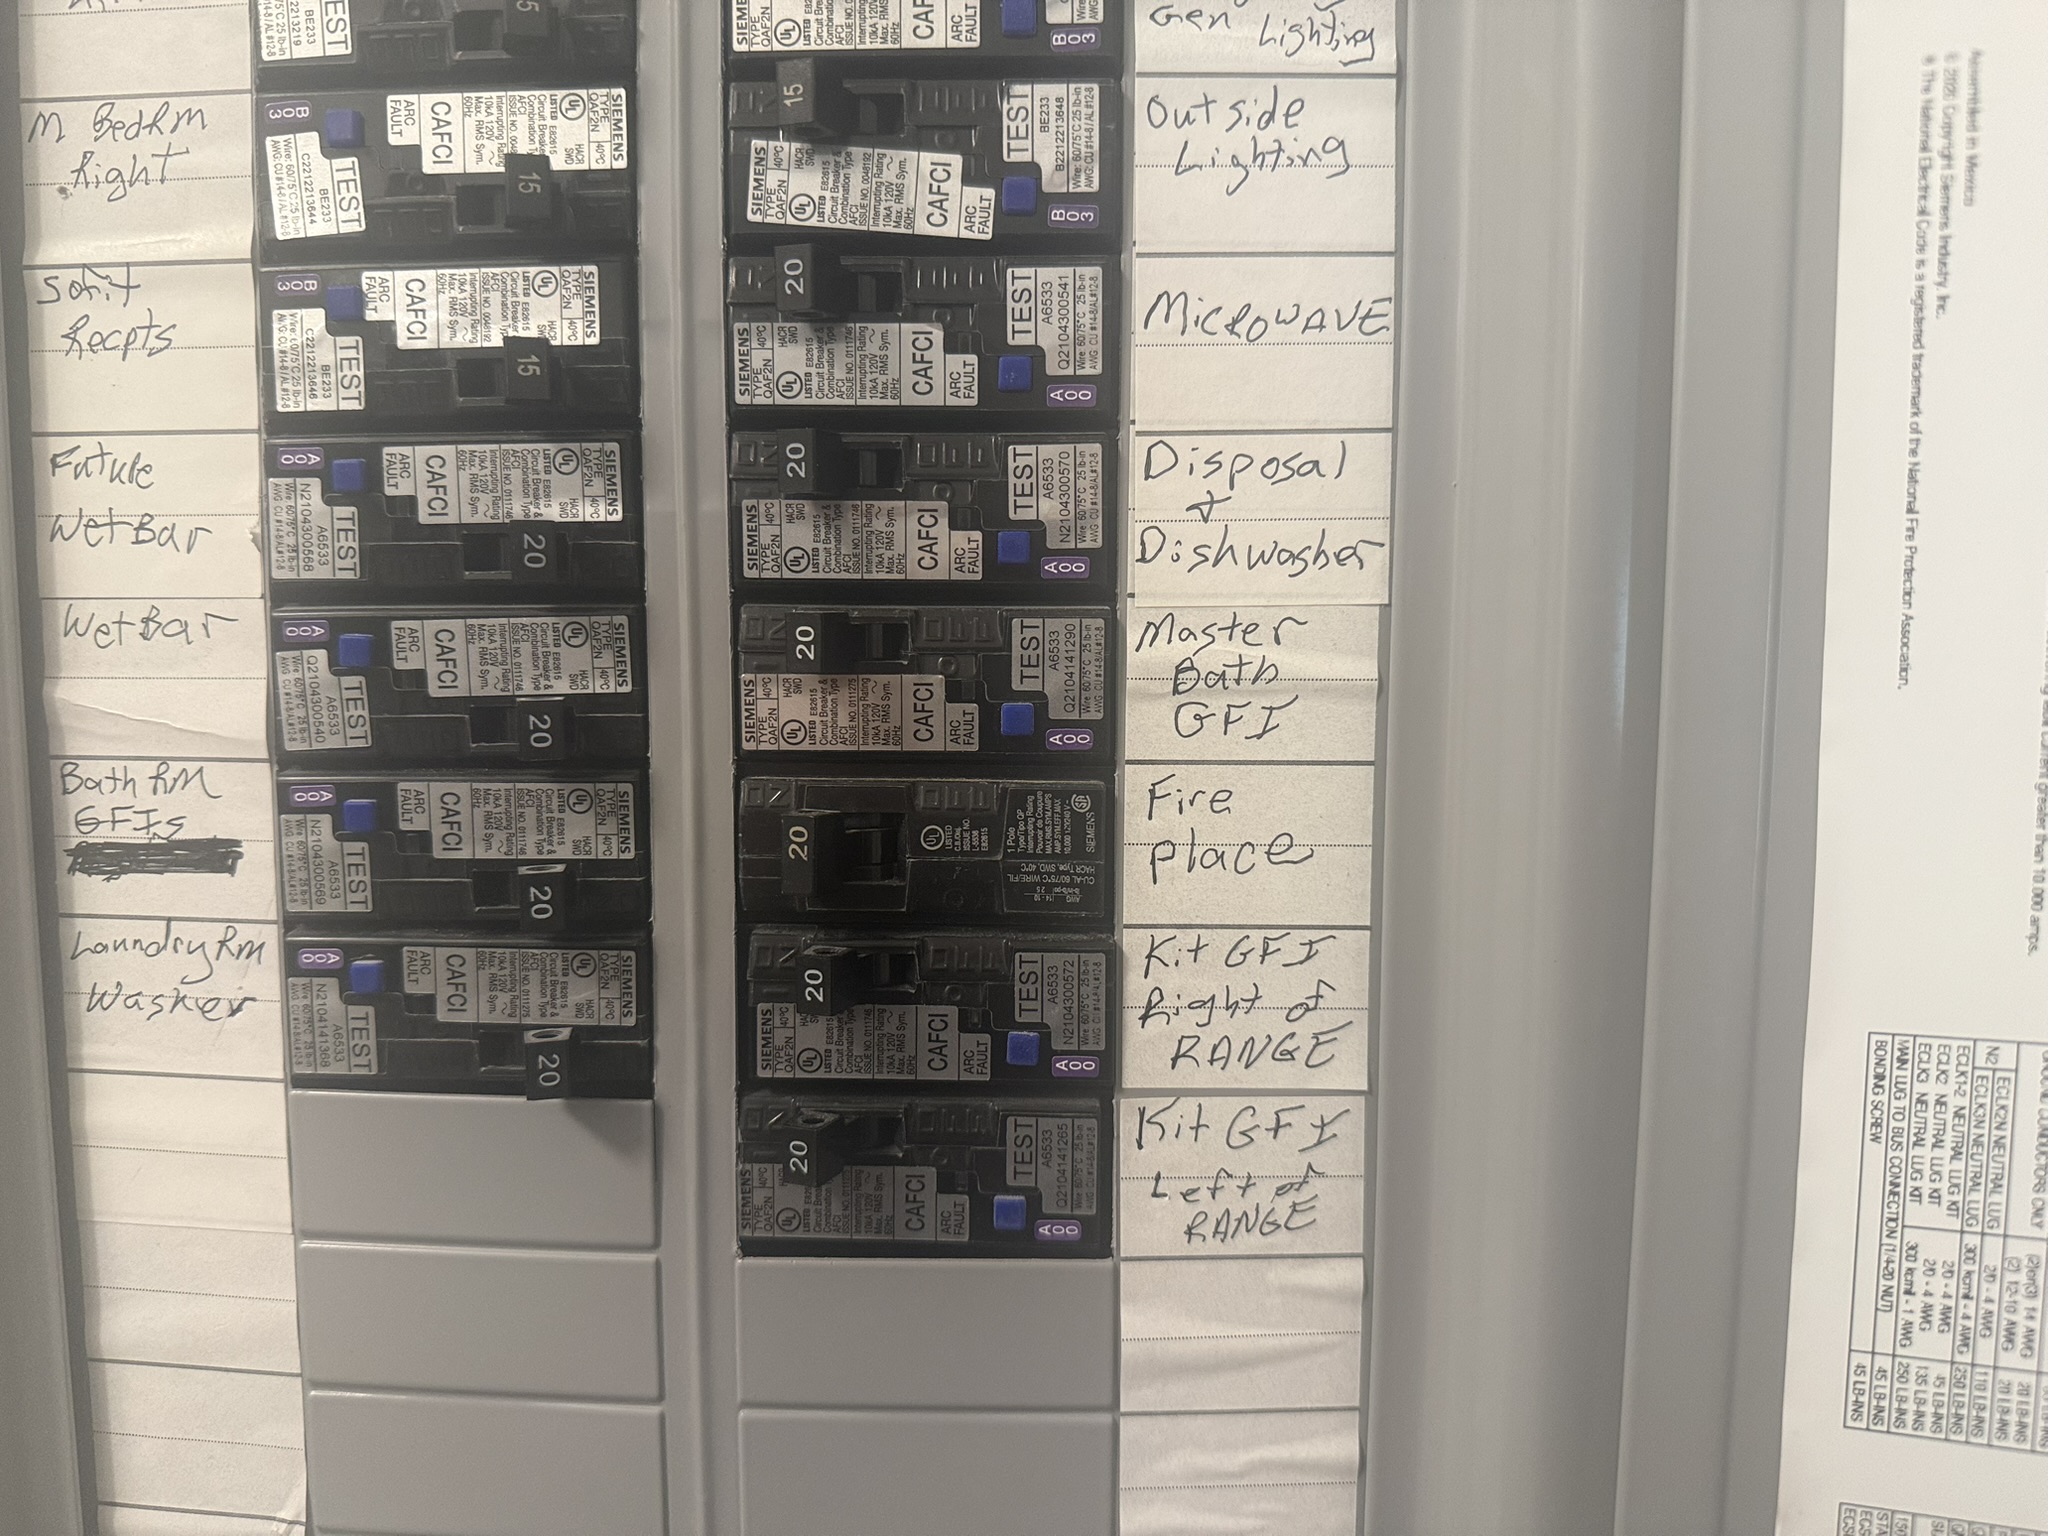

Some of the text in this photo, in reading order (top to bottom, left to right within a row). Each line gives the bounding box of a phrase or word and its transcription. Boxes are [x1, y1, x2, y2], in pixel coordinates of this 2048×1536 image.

[305, 10, 314, 44] BE233
[951, 18, 962, 42] ARC
[965, 5, 977, 44] FAULT
[402, 100, 416, 126] ARC
[589, 93, 600, 133] QAF2N
[602, 93, 610, 123] TYPE
[783, 84, 804, 108] 15
[1041, 97, 1049, 132] BE233
[28, 112, 65, 142] M
[390, 100, 404, 137] FAULT
[431, 101, 453, 165] CAFCI
[612, 93, 624, 162] SIEMENS
[1007, 90, 1030, 158] TEST
[70, 143, 190, 202] Right
[520, 172, 541, 193] 15
[752, 147, 766, 216] SIEMENS
[1174, 135, 1349, 196] Lighting
[320, 188, 331, 223] BE233
[336, 161, 363, 228] TEST
[926, 161, 952, 228] CAFCI
[978, 195, 992, 236] FAULT
[963, 204, 977, 234] ARC
[365, 277, 378, 313] FAULT
[378, 278, 389, 303] ARC
[784, 259, 804, 295] 20
[405, 279, 427, 341] CAFCI
[584, 270, 596, 339] SIEMENS
[1011, 271, 1033, 339] TEST
[340, 340, 361, 407] TEST
[518, 355, 540, 376] 15
[738, 328, 750, 396] SIEMENS
[912, 331, 934, 396] CAFCI
[963, 360, 975, 399] FAULT
[950, 370, 961, 399] ARC
[50, 442, 154, 489] Future
[386, 453, 398, 490] FAULT
[399, 453, 411, 479] ARC
[786, 442, 806, 478] 20
[1013, 448, 1034, 514] TEST
[1145, 441, 1346, 490] Disposal
[426, 455, 449, 517] CAFCI
[605, 449, 619, 517] SIEMENS
[317, 525, 328, 567] A6533
[336, 512, 357, 577] TEST
[524, 534, 546, 569] 20
[747, 504, 759, 571] SIEMENS
[917, 509, 939, 571] CAFCI
[968, 537, 980, 574] FAULT
[1139, 524, 1386, 577] Dishwasher
[955, 547, 966, 574] ARC
[1902, 545, 1916, 609] Protection
[394, 627, 408, 664] FAULT
[407, 627, 420, 653] ARC
[796, 626, 814, 660] 20
[1019, 619, 1040, 684] TEST
[1136, 612, 1307, 652] Master
[435, 628, 458, 690] CAFCI
[613, 623, 628, 688] SIEMENS
[1173, 650, 1279, 696] Bath
[344, 681, 369, 745] TEST
[529, 714, 552, 748] 20
[744, 679, 755, 743] SIEMENS
[913, 681, 934, 742] CAFCI
[949, 719, 961, 745] ARC
[963, 709, 975, 745] FAULT
[1174, 695, 1297, 739] GFI
[60, 762, 137, 799] Bath
[413, 789, 426, 815] ARC
[1148, 773, 1233, 819] Fire
[401, 788, 413, 825] FAULT
[441, 792, 462, 852] CAFCI
[619, 790, 631, 854] SIEMENS
[788, 825, 809, 860] 20
[1085, 811, 1096, 853] SIEMENS
[346, 847, 368, 910] TEST
[529, 885, 553, 919] 20
[71, 917, 213, 985] Laundry
[406, 950, 419, 986] FAULT
[419, 950, 431, 975] ARC
[1144, 933, 1336, 979] Kit GFI
[86, 981, 257, 1021] Washer
[446, 953, 467, 1013] CAFCI
[622, 955, 633, 1018] SIEMENS
[805, 968, 824, 1002] 20
[1019, 954, 1039, 1017] TEST
[1141, 983, 1263, 1027] Right
[350, 1011, 373, 1073] TEST
[761, 1008, 772, 1072] SIEMENS
[928, 1013, 949, 1072] CAFCI
[963, 1049, 975, 1075] ARC
[976, 1040, 989, 1075] FAULT
[1172, 1021, 1352, 1070] RANGE
[538, 1053, 560, 1086] 20
[1872, 1040, 1888, 1096] BONDING
[1137, 1097, 1210, 1150] Kit
[1868, 1100, 1885, 1144] SCREW
[1912, 1092, 1928, 1150] NEUTRAL
[789, 1140, 809, 1173] 20
[1014, 1118, 1033, 1180] TEST
[740, 1167, 752, 1230] SIEMENS
[905, 1174, 925, 1232] CAFCI
[1150, 1167, 1257, 1204] Left
[940, 1210, 952, 1235] ARC
[953, 1201, 965, 1236] FAULT
[1184, 1192, 1319, 1244] RANGE
